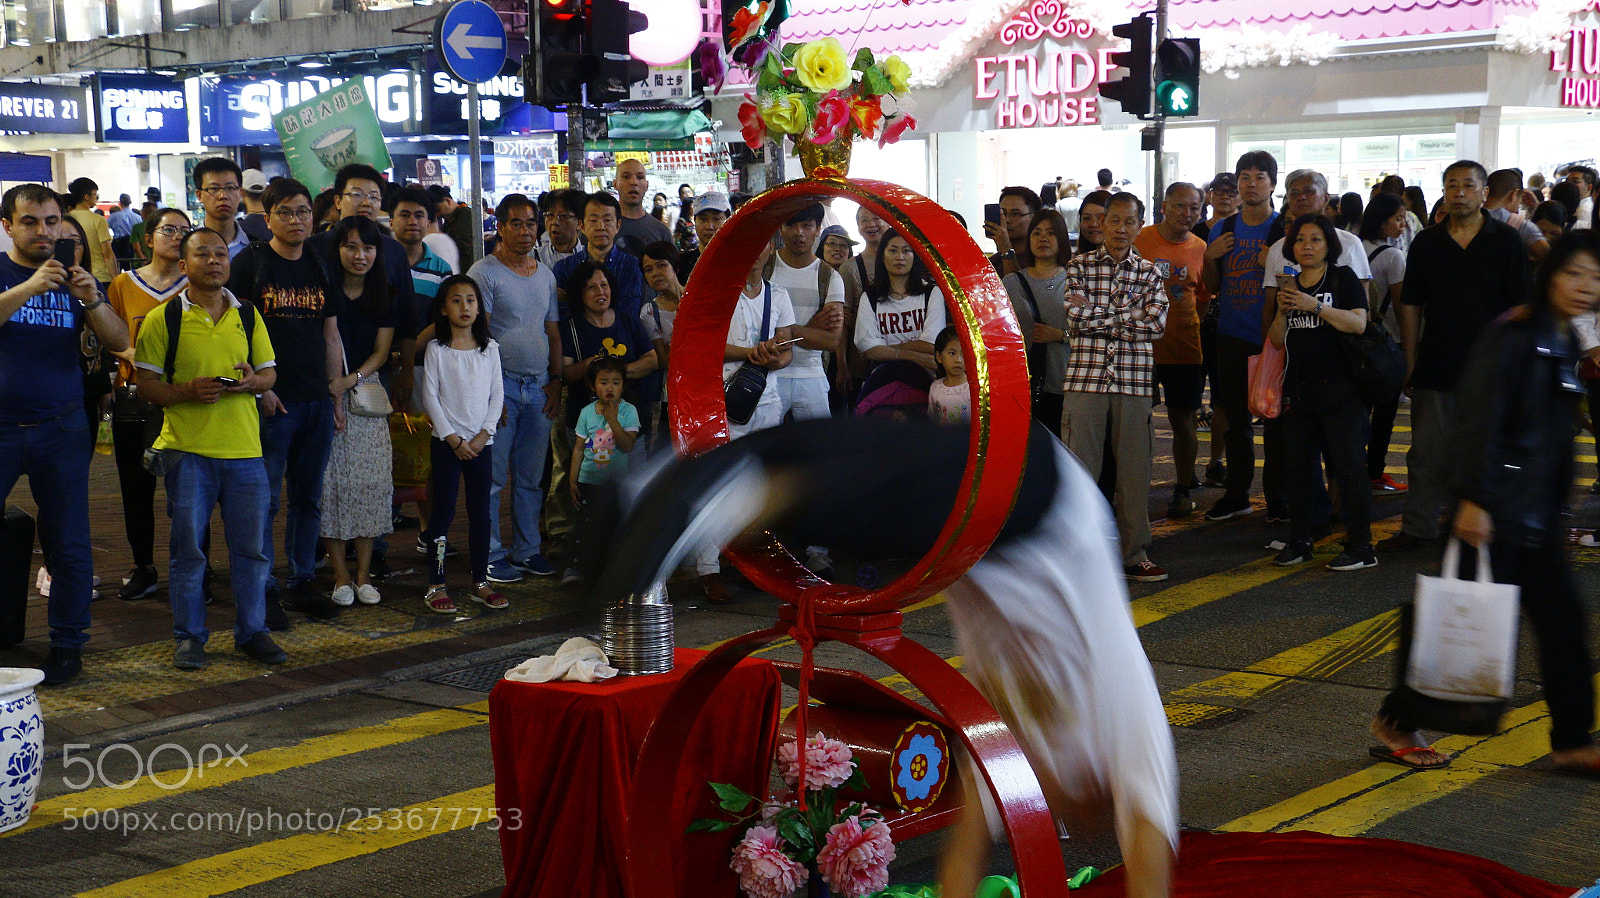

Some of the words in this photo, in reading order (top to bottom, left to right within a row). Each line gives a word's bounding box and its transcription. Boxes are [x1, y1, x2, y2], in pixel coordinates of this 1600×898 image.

[0, 95, 56, 118] REVER
[61, 99, 79, 119] 21
[102, 88, 184, 109] SUNING
[998, 97, 1097, 127] HOUSE
[26, 292, 71, 311] UNTAIN
[20, 306, 63, 327] FOREST
